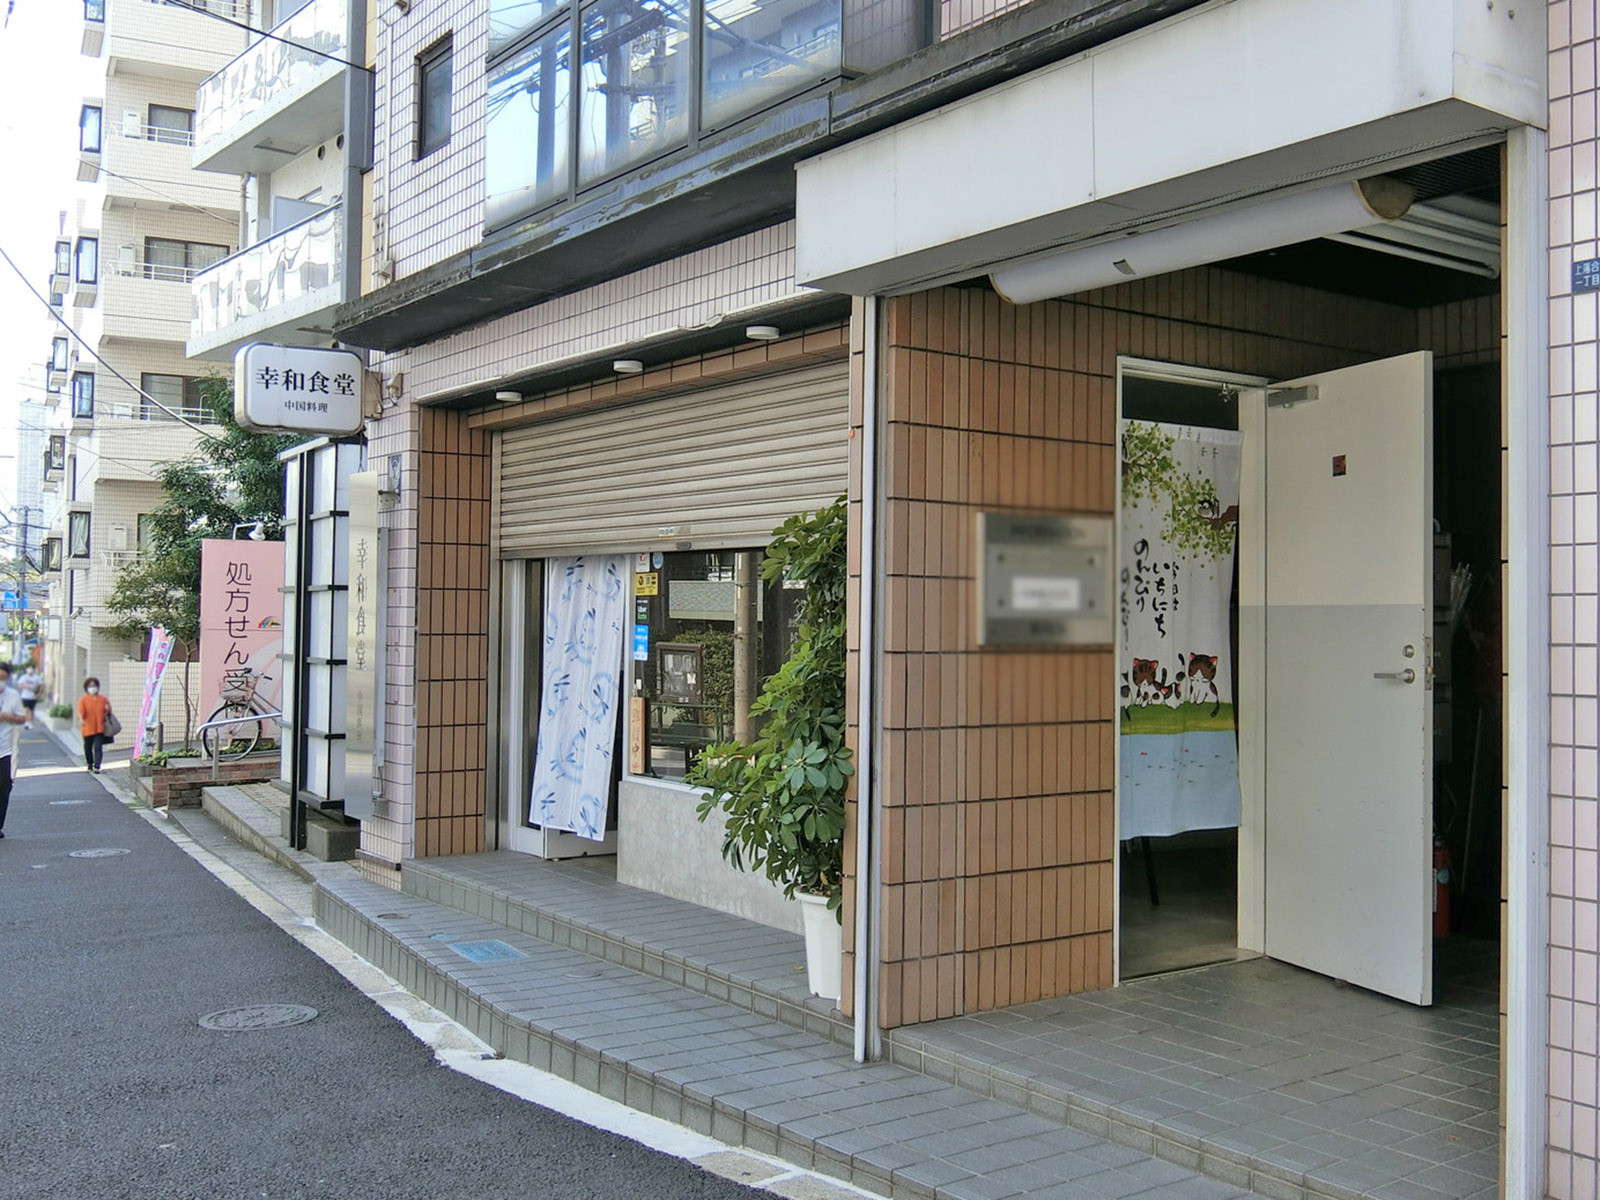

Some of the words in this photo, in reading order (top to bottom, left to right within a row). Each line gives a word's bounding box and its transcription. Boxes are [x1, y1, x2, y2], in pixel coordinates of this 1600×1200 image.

[255, 366, 355, 397] 幸和食堂
[284, 399, 328, 414] 中国料理
[1133, 538, 1151, 613] のんびり
[355, 538, 369, 672] 幸和食堂
